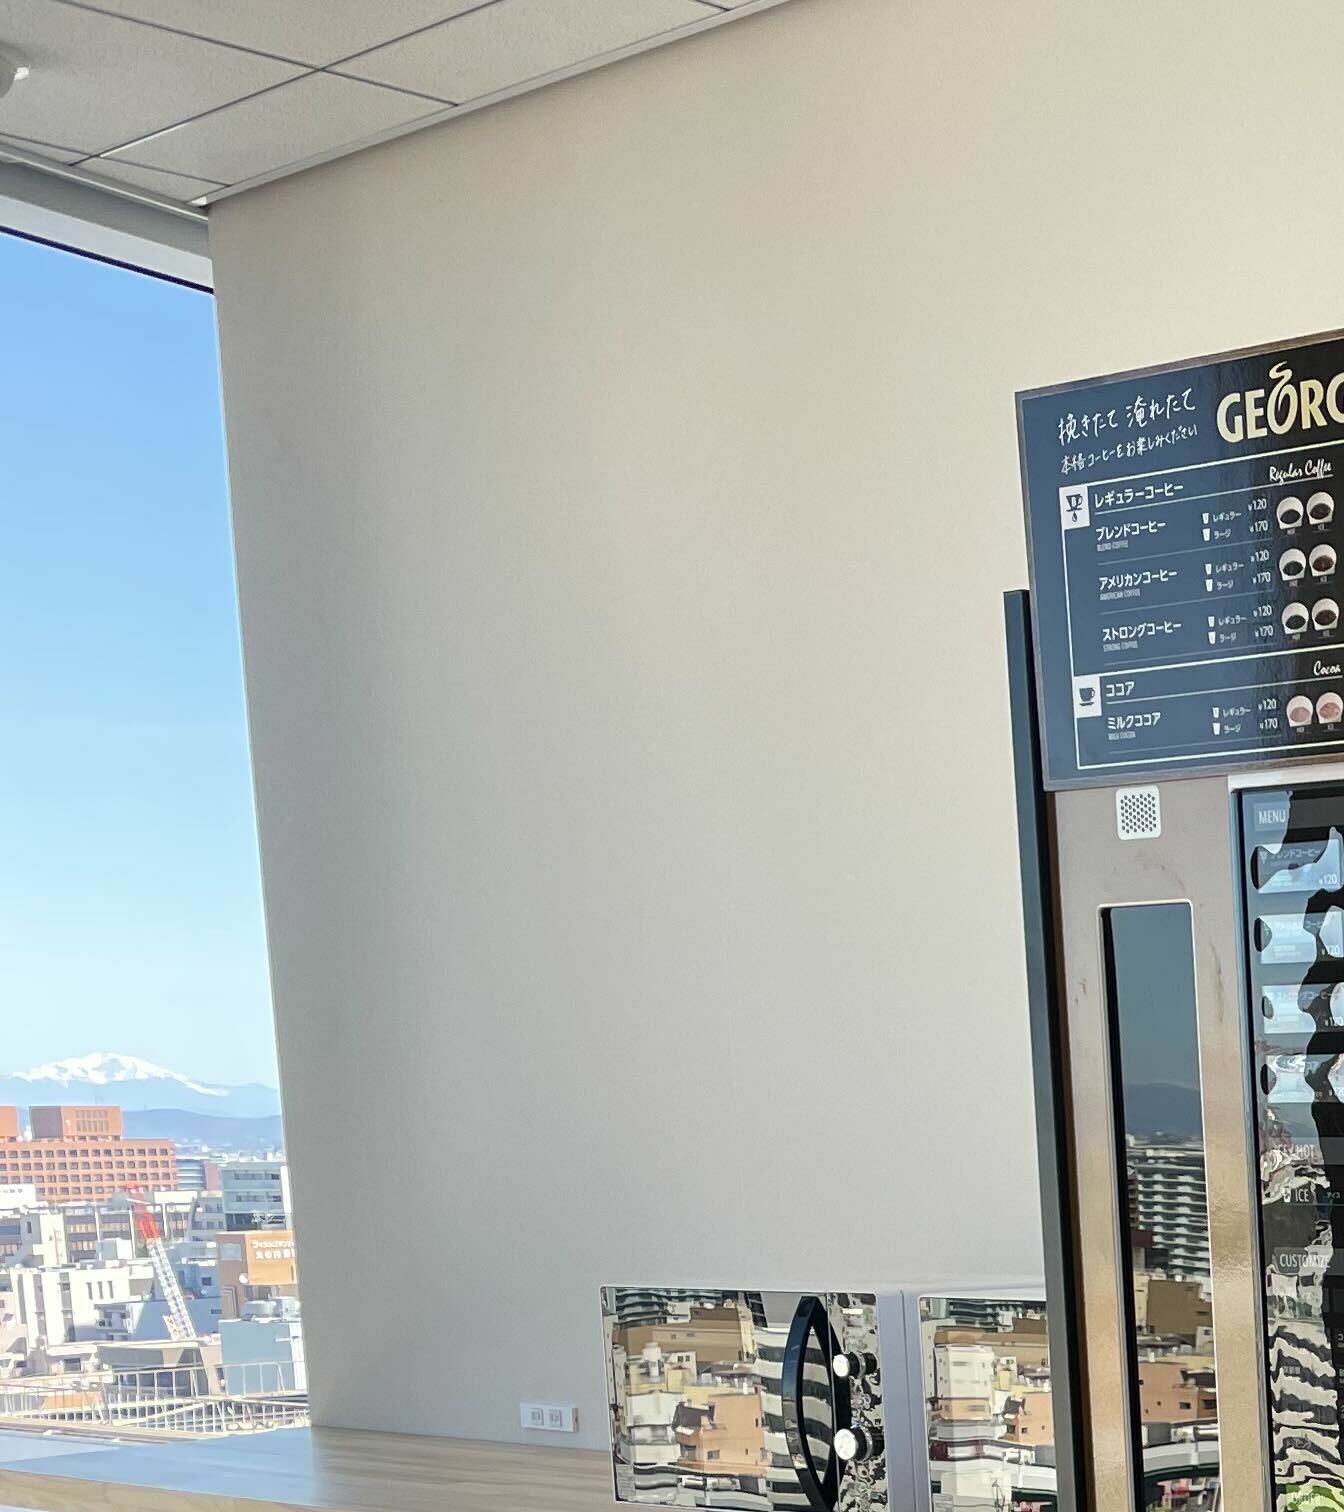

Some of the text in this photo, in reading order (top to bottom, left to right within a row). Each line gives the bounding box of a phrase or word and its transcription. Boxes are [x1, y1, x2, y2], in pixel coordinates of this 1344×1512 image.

[1094, 485, 1183, 507] レギュラーコーヒー
[1096, 521, 1166, 540] ブレンドコーヒー
[1099, 570, 1177, 590] アメリカンコーヒー
[1102, 623, 1181, 641] ストロングコーヒー
[1313, 662, 1341, 676] Cocoa
[1106, 682, 1134, 697] ココア
[1107, 713, 1161, 730] ミルクココア
[1259, 809, 1286, 825] MENU
[1295, 1189, 1309, 1203] ICE
[1279, 1253, 1330, 1269] CUSTOMIZE
